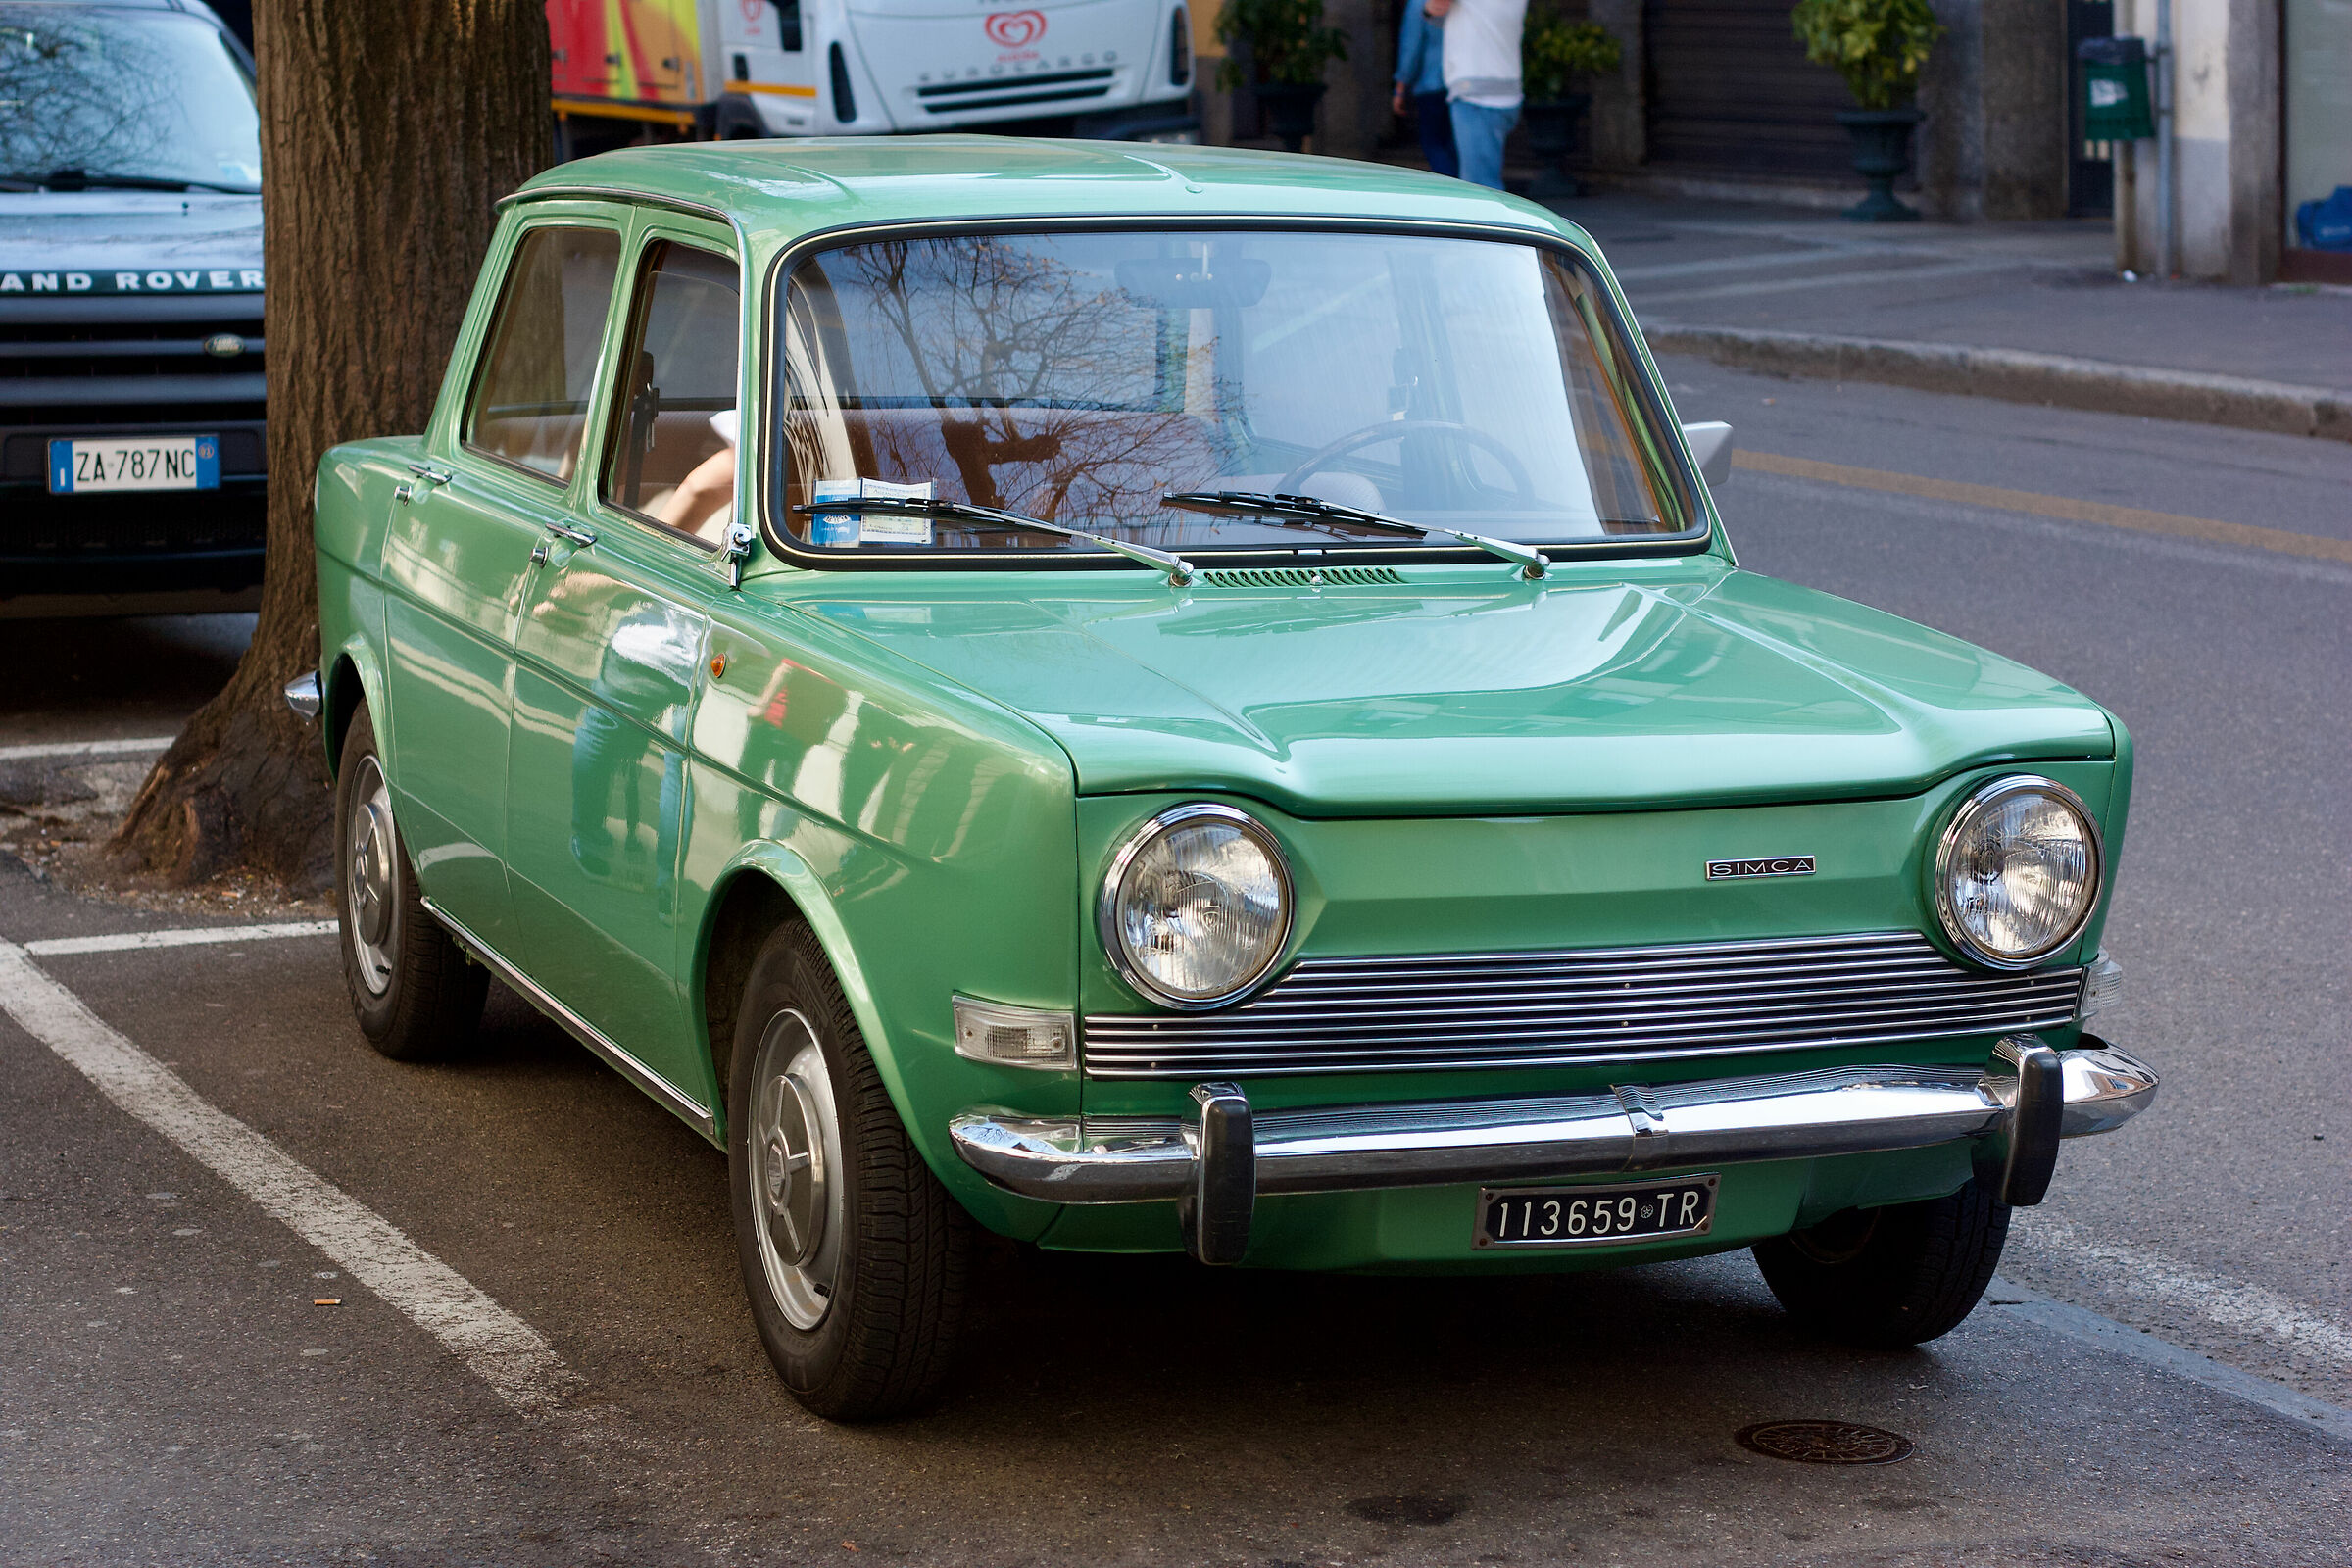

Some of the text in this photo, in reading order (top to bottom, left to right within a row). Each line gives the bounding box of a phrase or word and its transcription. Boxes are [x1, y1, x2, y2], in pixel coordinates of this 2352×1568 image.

[115, 270, 265, 291] ROVER
[1712, 859, 1812, 875] SIMCA
[1499, 1190, 1699, 1237] 113659 TR
